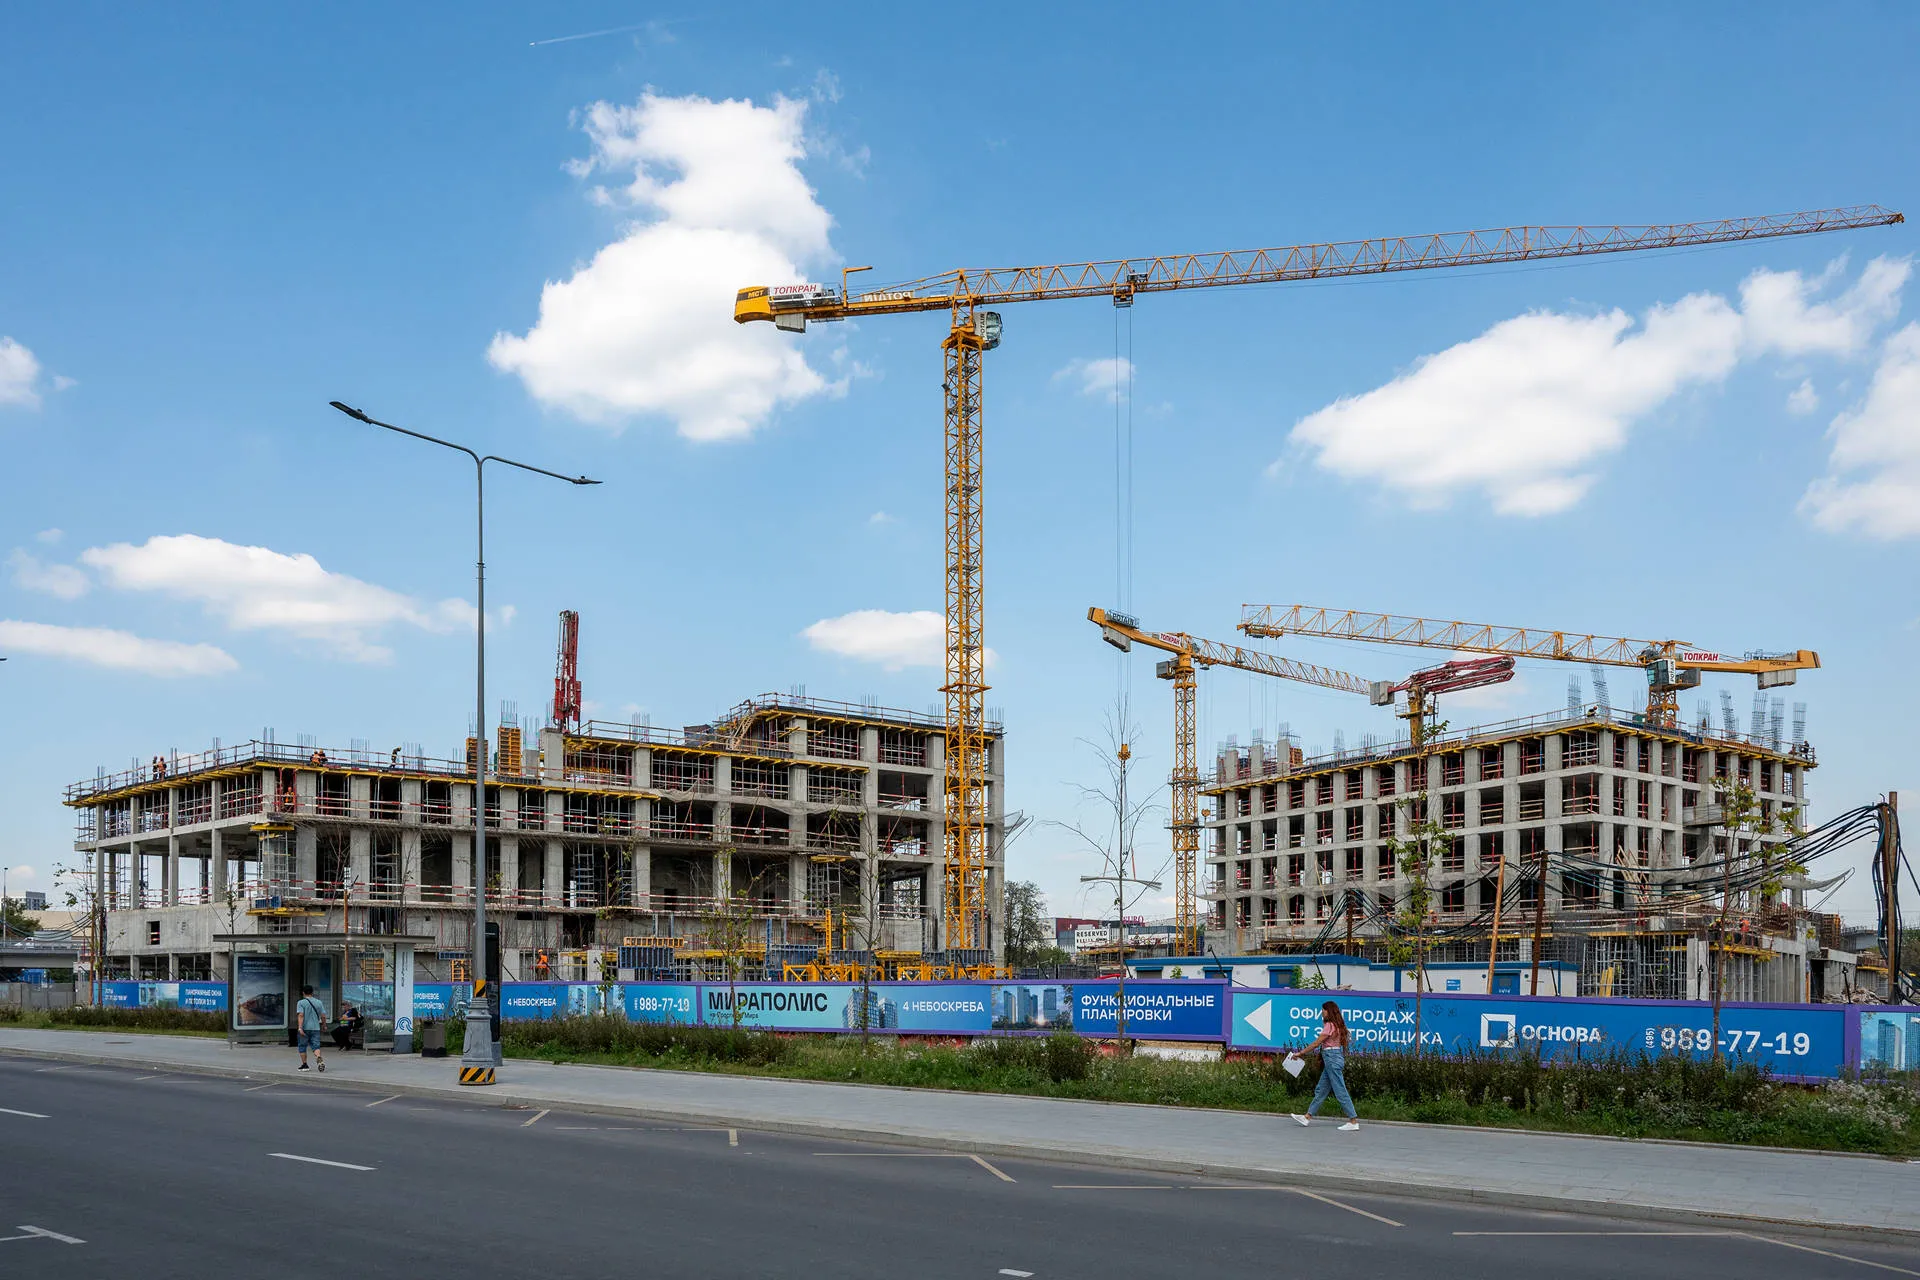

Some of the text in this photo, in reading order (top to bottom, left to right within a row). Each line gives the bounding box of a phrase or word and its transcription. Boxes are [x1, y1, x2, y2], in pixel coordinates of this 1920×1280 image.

[774, 285, 817, 295] ТОПКРАН
[1683, 652, 1719, 661] ТОПКРАН
[513, 998, 557, 1007] НЕБОСКРЕБА
[639, 997, 690, 1012] 989-77-19
[708, 991, 828, 1012] МИРАПОЛИС
[902, 1001, 985, 1013] 4 НЕБОСКРЕБА
[1081, 994, 1215, 1008] ФУНКЦИОНАЛЬНЫЕ
[1081, 1008, 1172, 1021] ПЛАНИРОВКИ
[1290, 1007, 1415, 1025] ОФИ ПРОДАЖ
[1289, 1025, 1310, 1038] ОТ
[1521, 1024, 1601, 1042] ОСНОВА
[1645, 1027, 1655, 1048] (495)
[1660, 1027, 1810, 1056] 989-77-19
